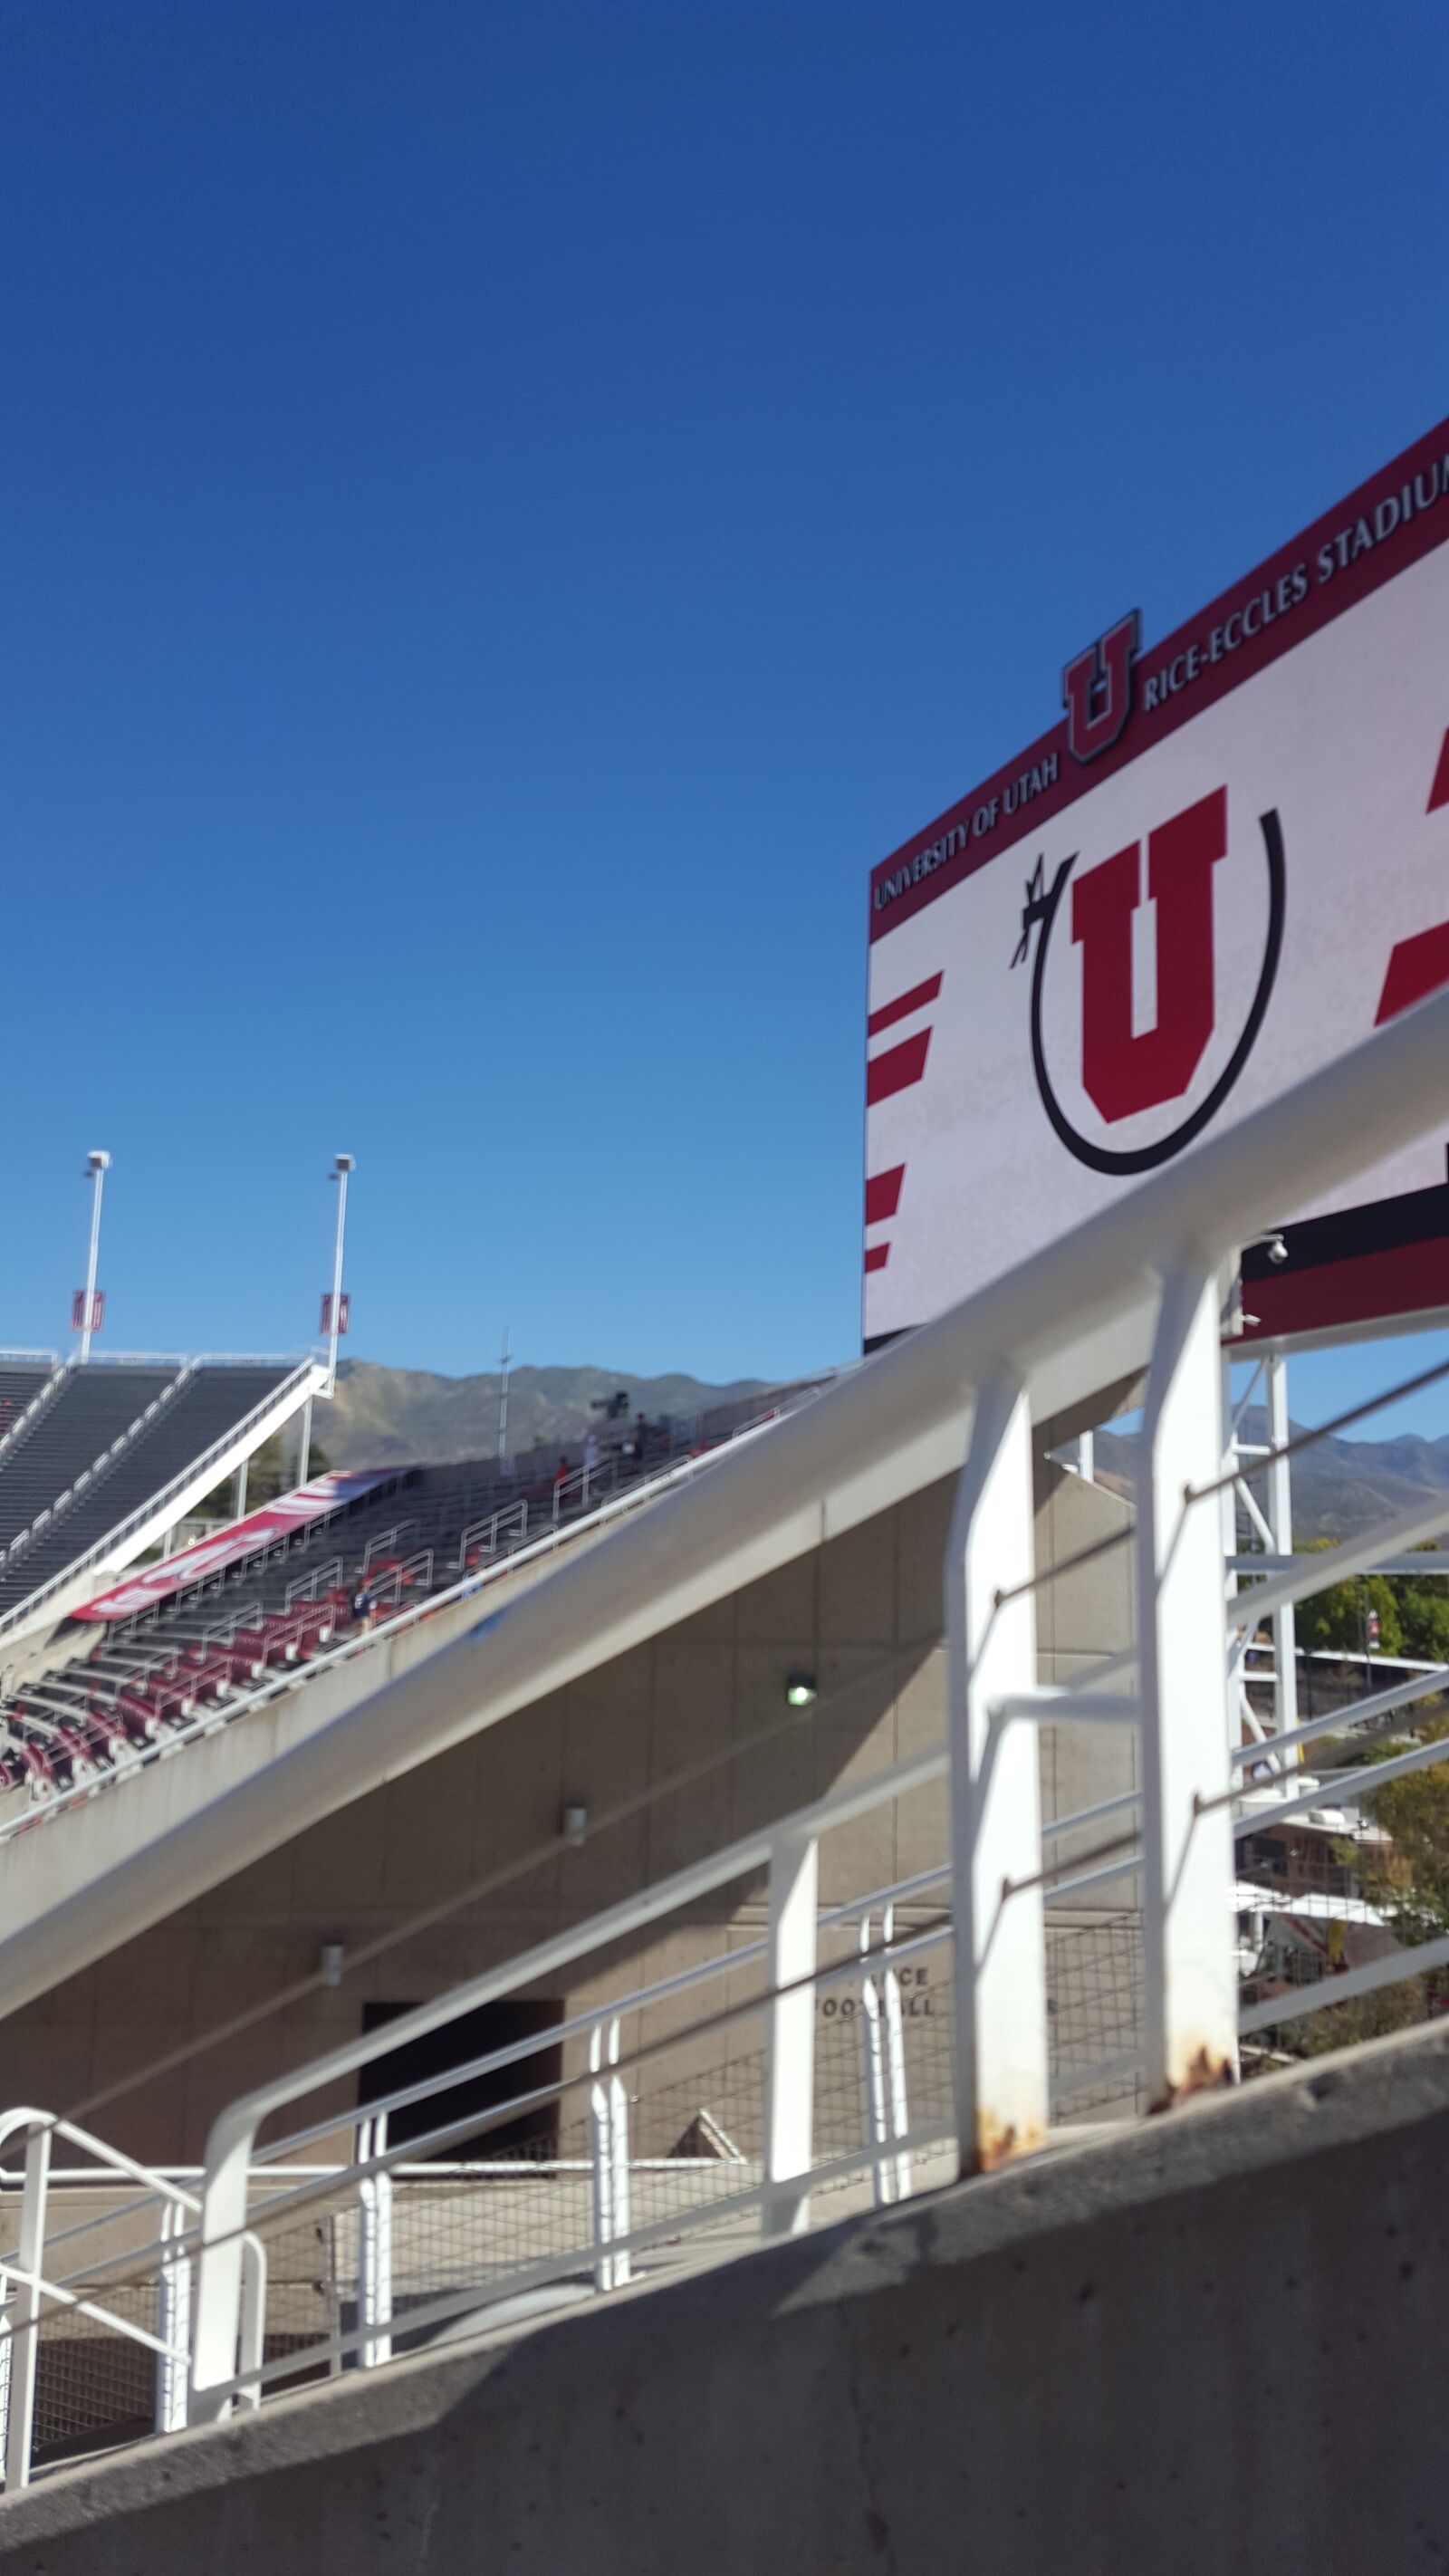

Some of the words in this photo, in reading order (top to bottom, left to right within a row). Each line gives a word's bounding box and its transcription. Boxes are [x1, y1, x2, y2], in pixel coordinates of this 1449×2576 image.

[1063, 607, 1142, 764] U
[1143, 564, 1309, 711] RICE-ECCLES
[874, 819, 969, 909] UNIVERSITY
[972, 797, 999, 838] OF
[1003, 752, 1059, 815] UTAH
